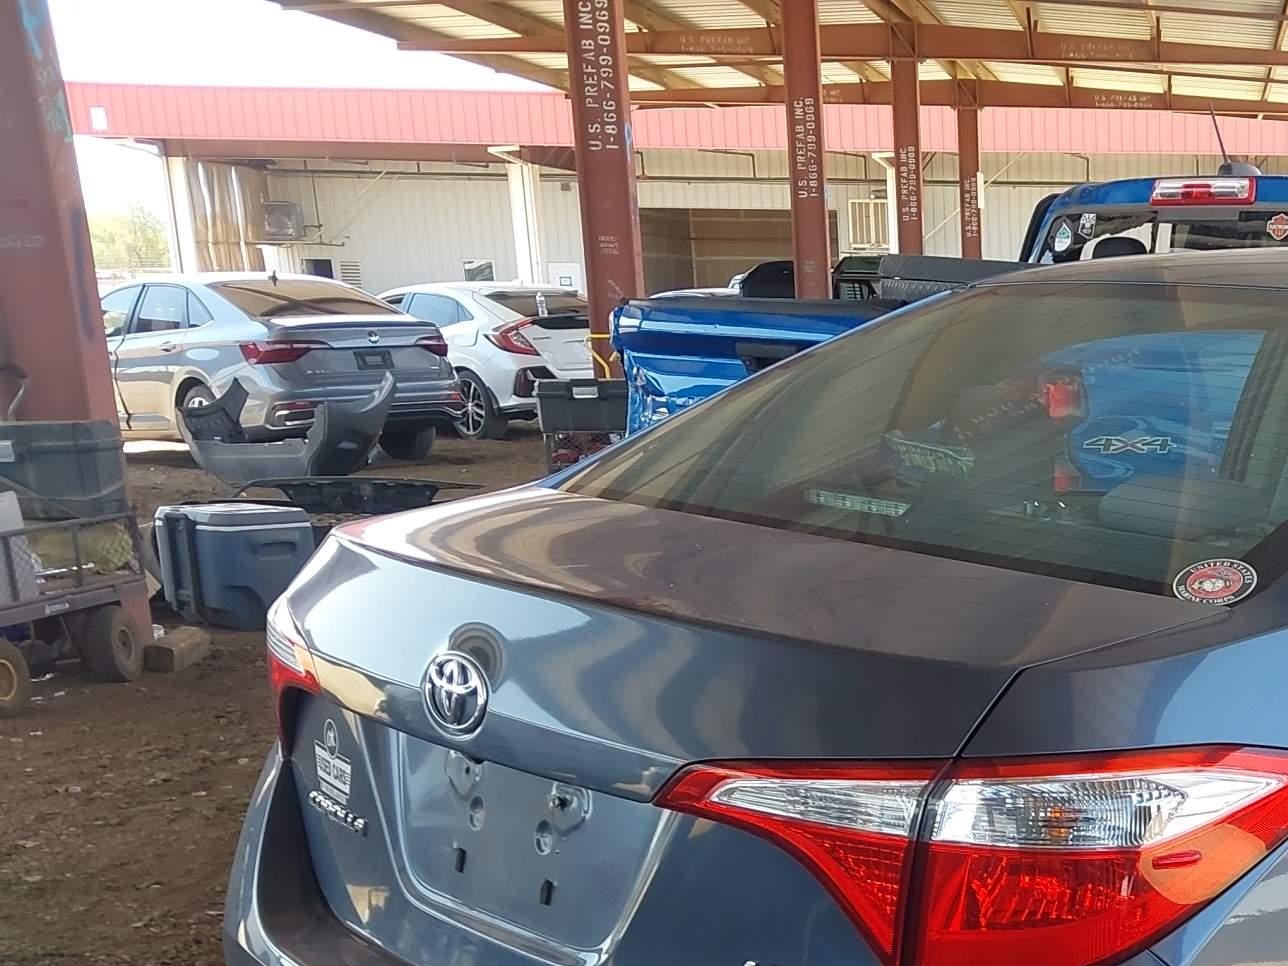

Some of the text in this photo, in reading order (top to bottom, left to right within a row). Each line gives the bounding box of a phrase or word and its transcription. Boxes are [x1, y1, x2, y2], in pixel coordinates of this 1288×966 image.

[578, 1, 602, 151] U.S. PREFAB INC
[595, 0, 619, 150] 1-866-799-0969
[794, 96, 808, 198] U.S. PREFAB INC.
[804, 97, 819, 197] 1-866-799-0969
[1177, 584, 1236, 604] MARINE CORPS
[1189, 561, 1253, 584] UNITED STATES
